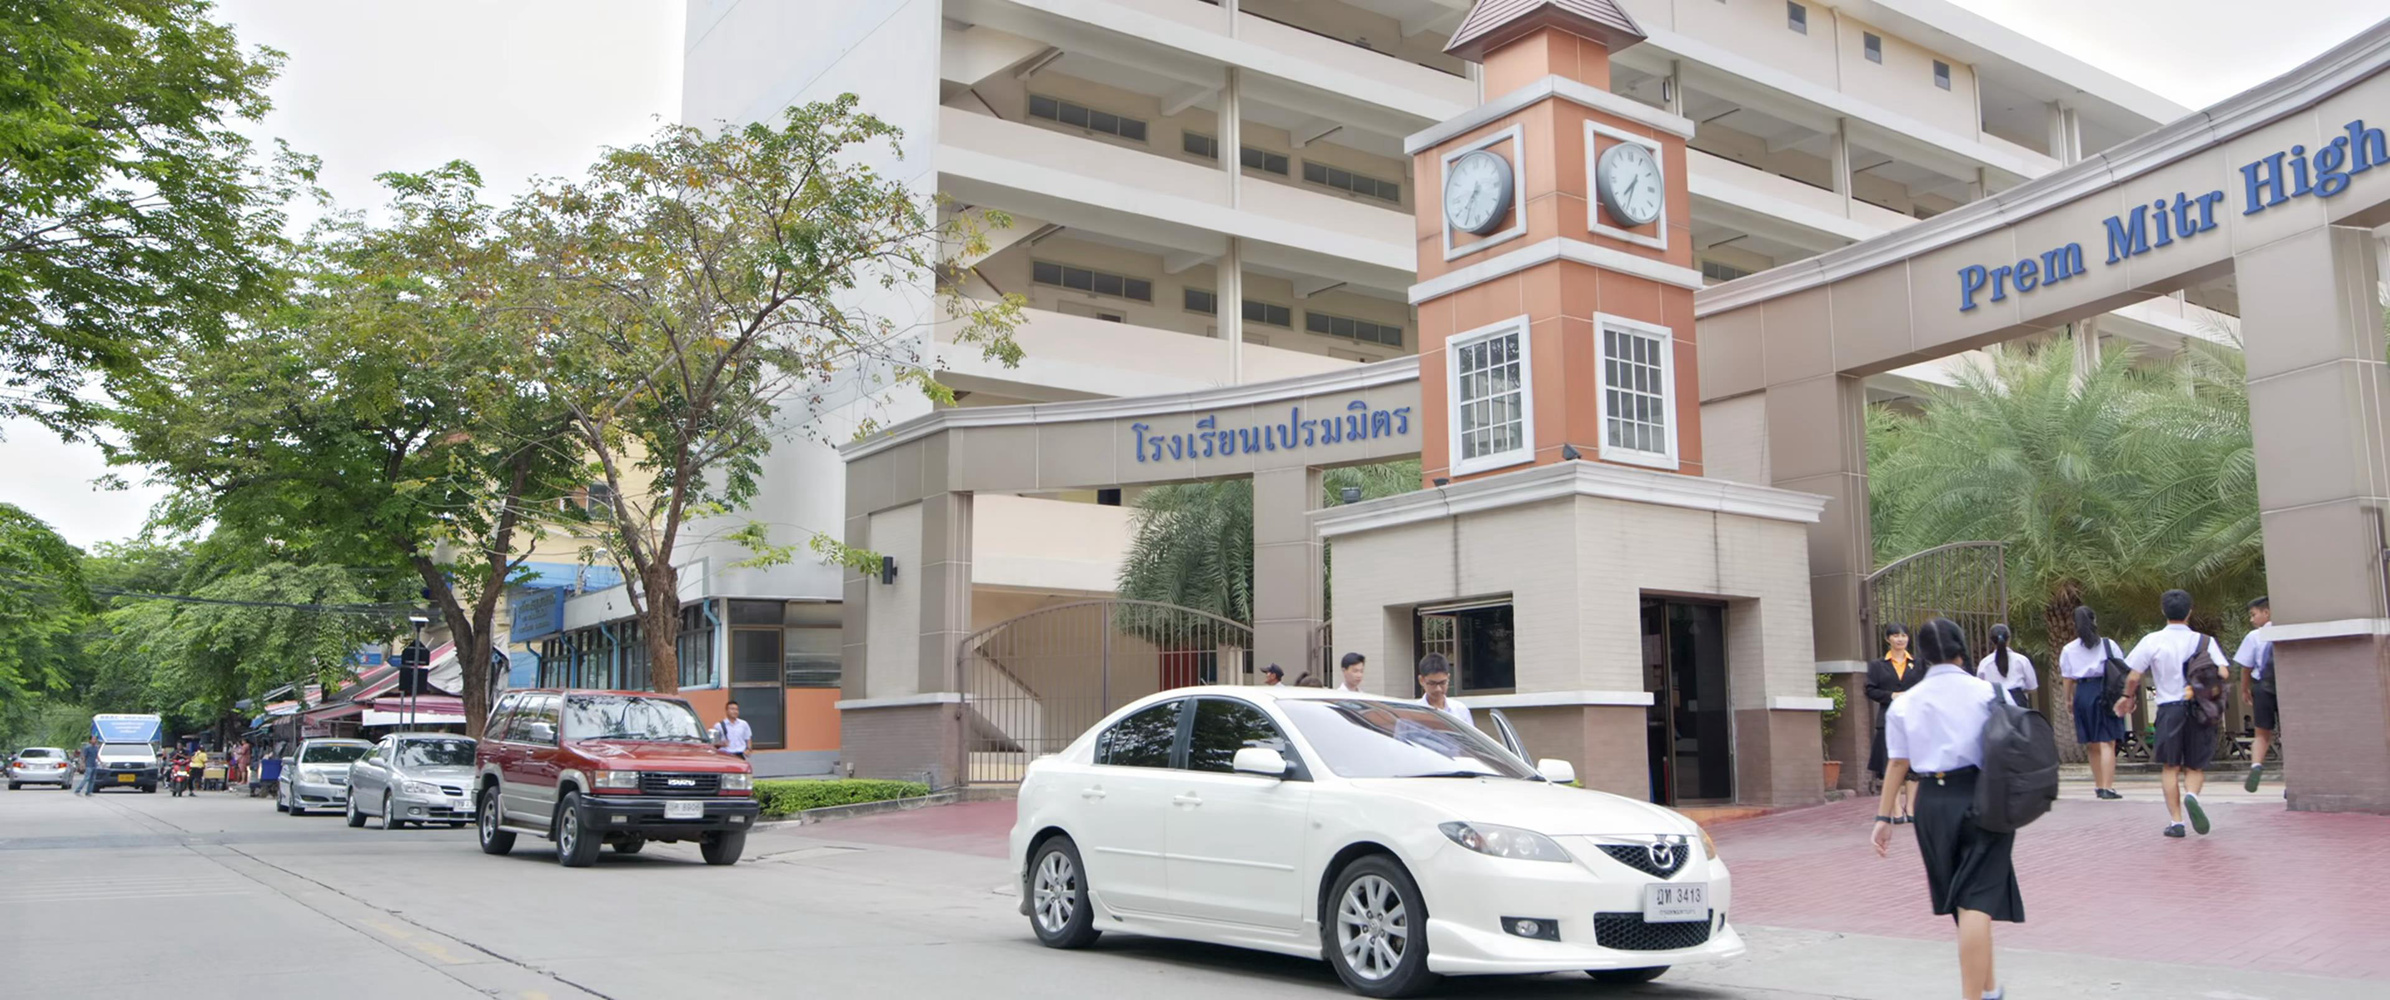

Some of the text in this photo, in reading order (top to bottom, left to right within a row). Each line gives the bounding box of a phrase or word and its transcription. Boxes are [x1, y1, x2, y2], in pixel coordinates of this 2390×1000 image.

[1957, 118, 2390, 312] Prem Mitr High
[1131, 400, 1411, 462] โรงเรียนเปรมมิตร
[1677, 888, 1701, 903] 3413
